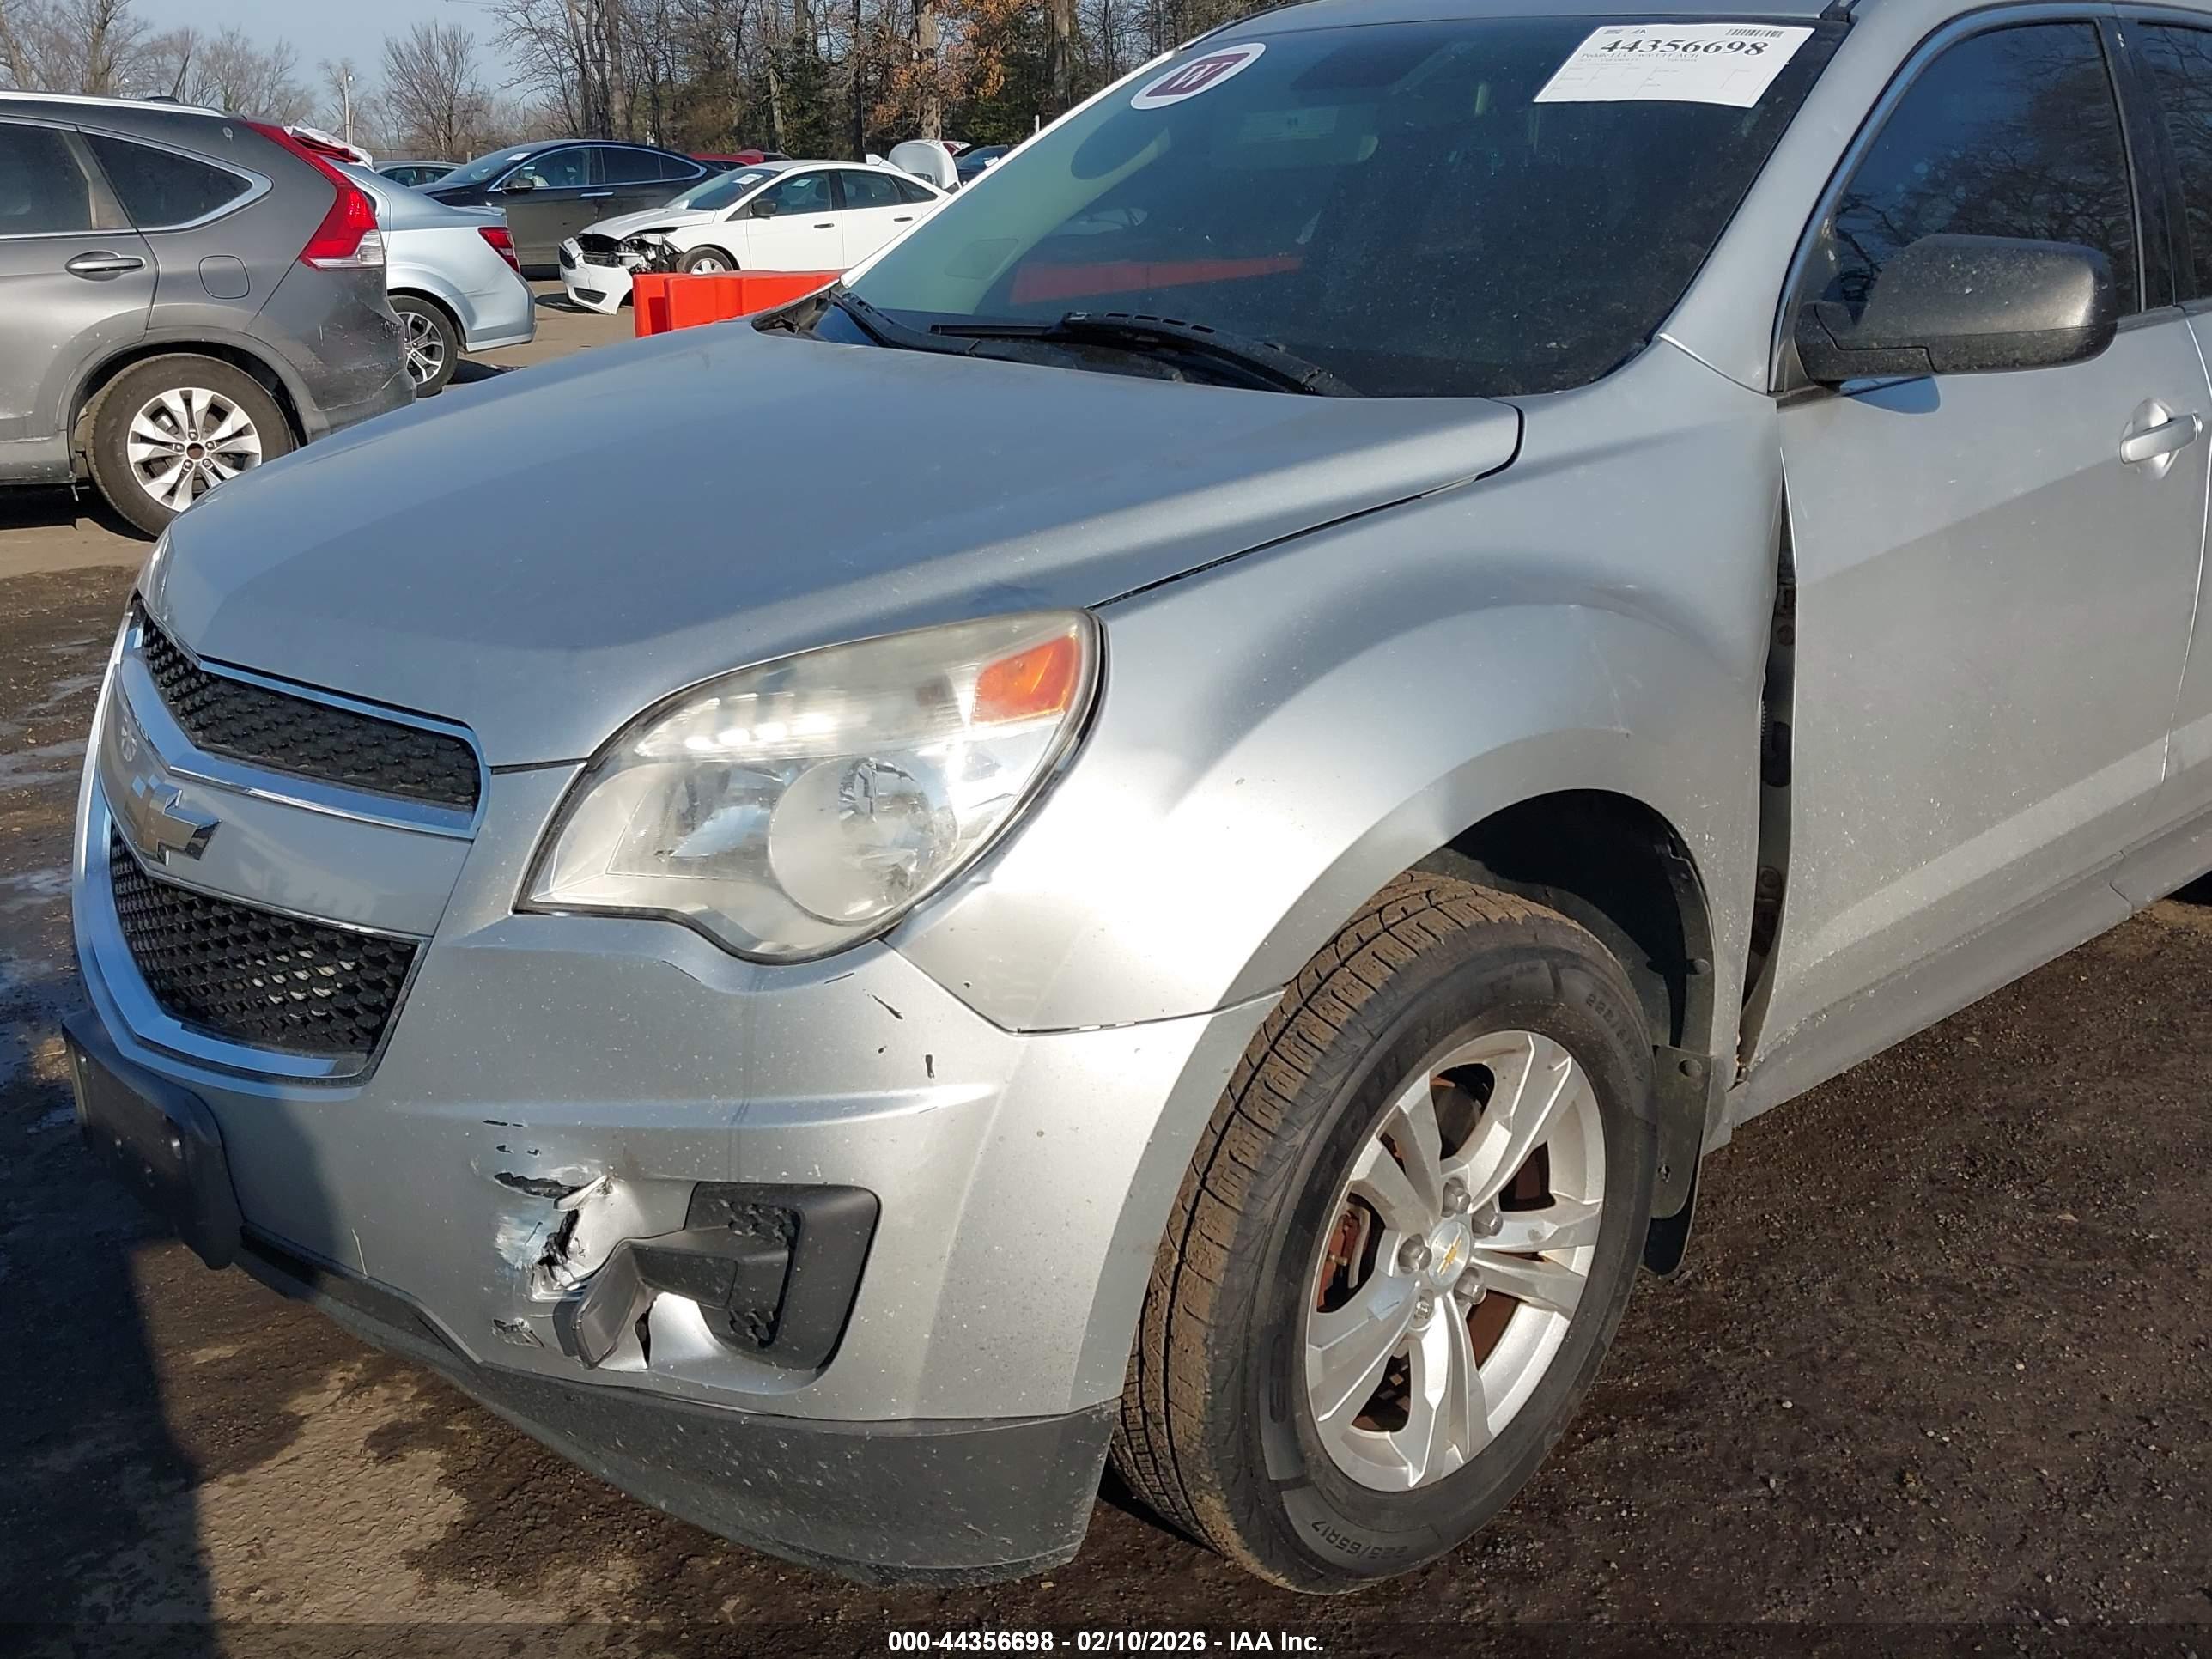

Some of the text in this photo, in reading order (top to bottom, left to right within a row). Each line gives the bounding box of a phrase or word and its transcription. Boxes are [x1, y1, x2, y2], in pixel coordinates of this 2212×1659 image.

[1600, 39, 1769, 55] 44356698
[1168, 61, 1235, 89] W
[1311, 1520, 1408, 1559] 225/65R17
